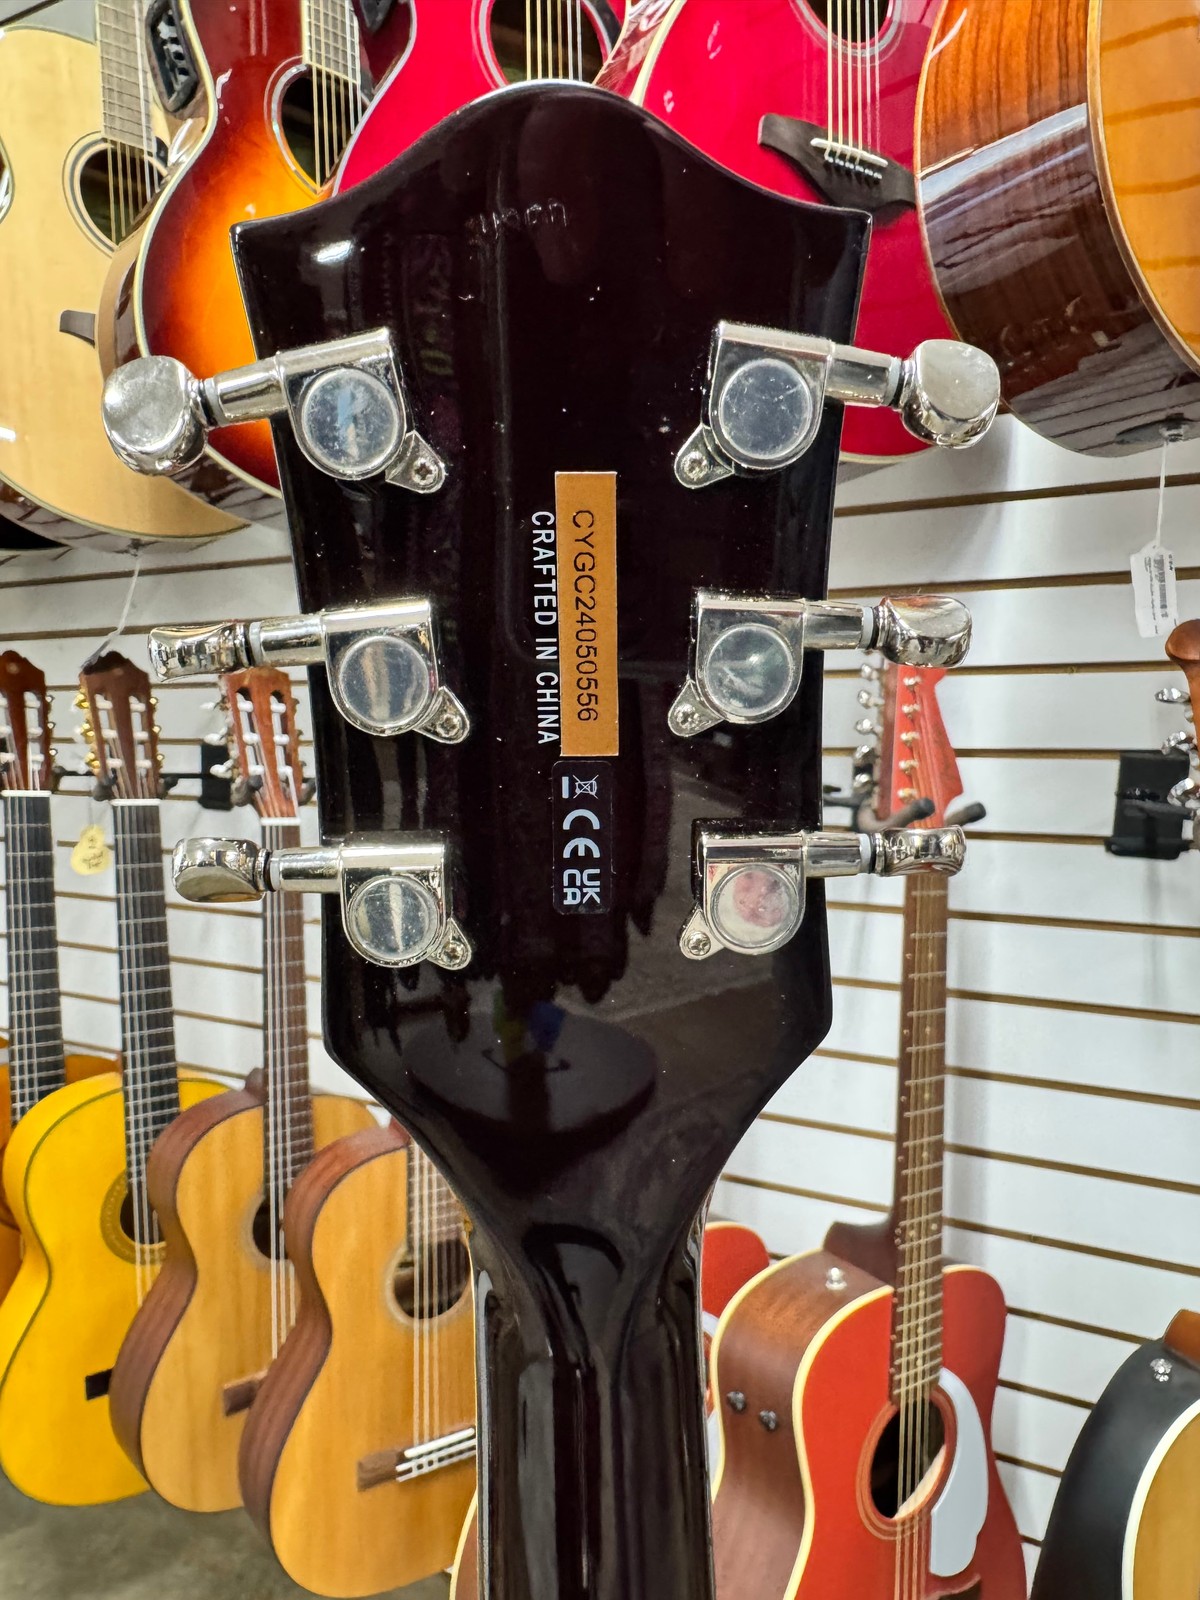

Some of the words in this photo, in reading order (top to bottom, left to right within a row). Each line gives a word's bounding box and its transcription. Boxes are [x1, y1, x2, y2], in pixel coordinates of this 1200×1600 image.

[531, 511, 557, 626] CRAFTED
[572, 509, 599, 722] CYGC24050556
[535, 637, 558, 660] IN
[535, 671, 560, 744] CHINA
[562, 808, 601, 859] CE
[562, 868, 582, 905] CA
[582, 868, 601, 905] UK
